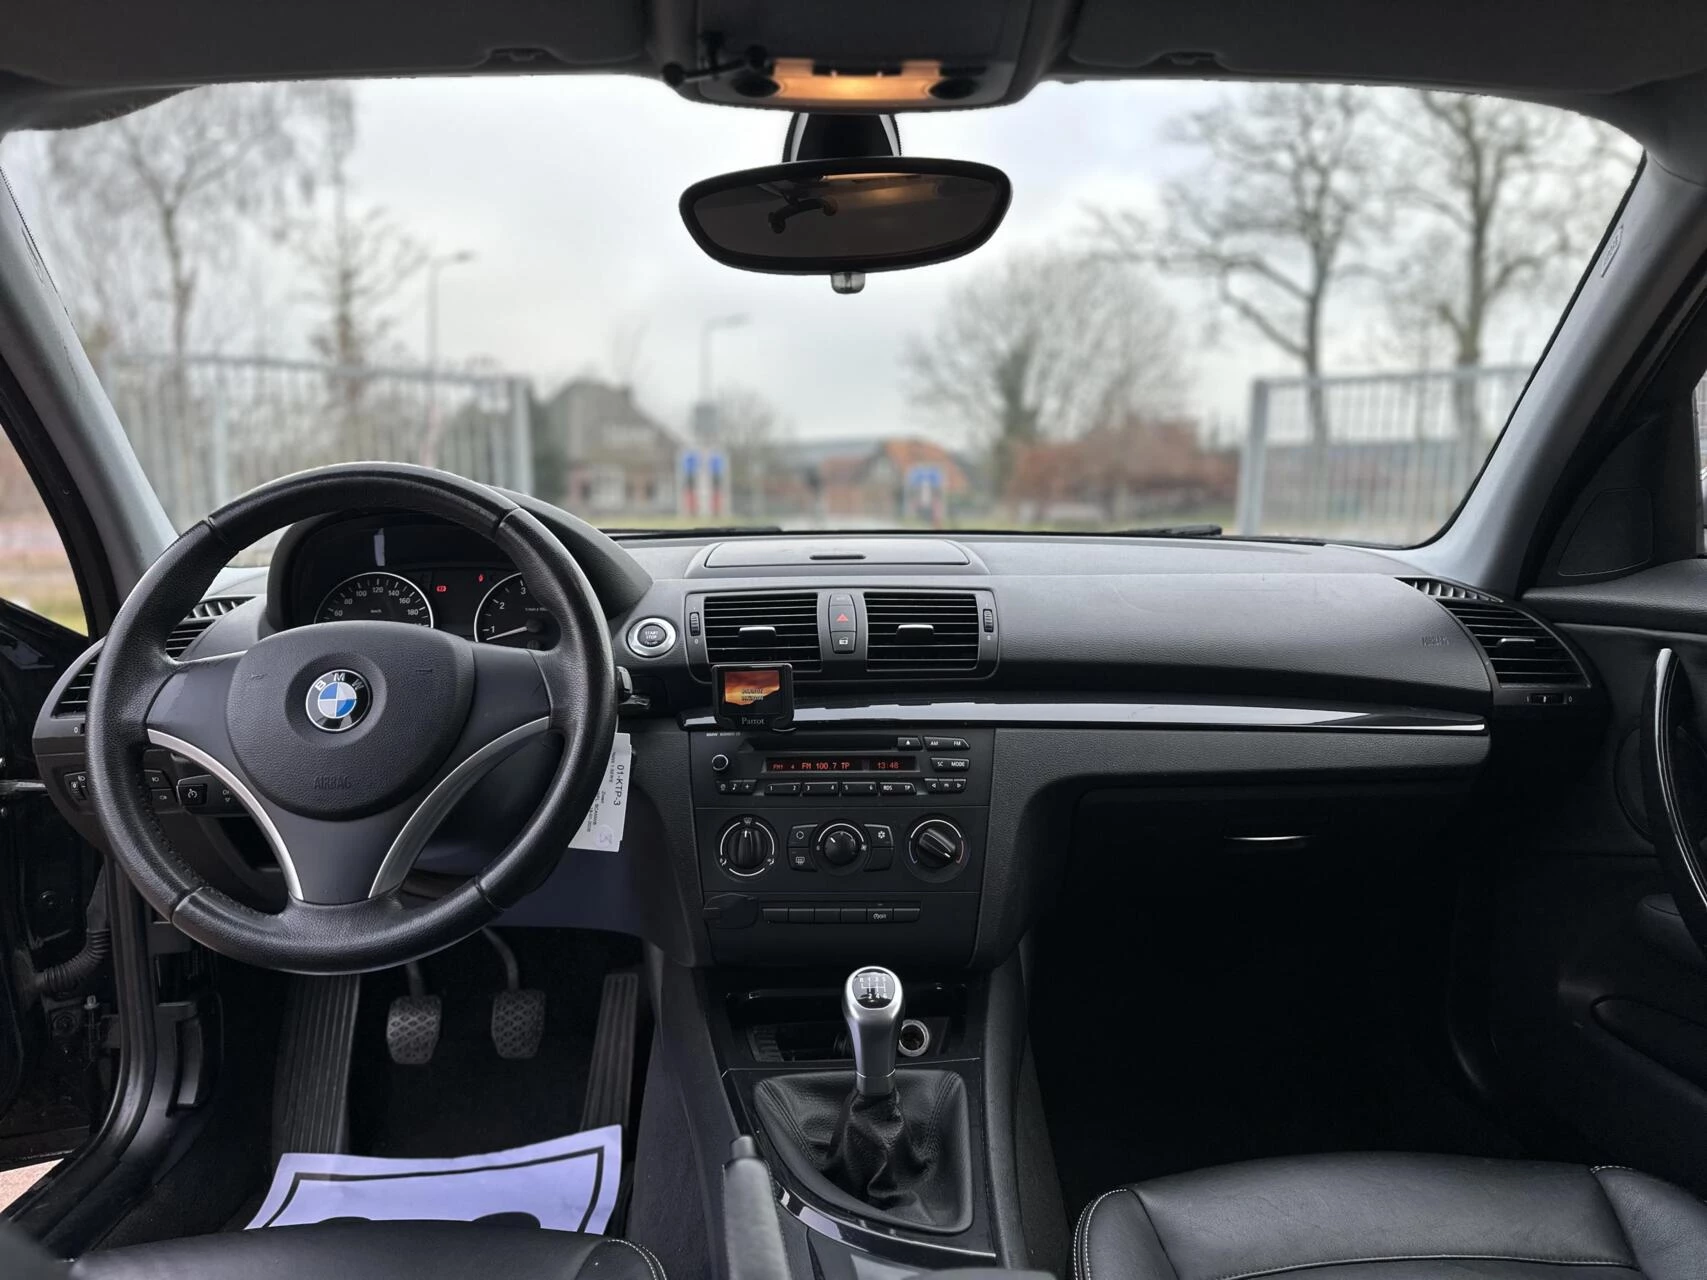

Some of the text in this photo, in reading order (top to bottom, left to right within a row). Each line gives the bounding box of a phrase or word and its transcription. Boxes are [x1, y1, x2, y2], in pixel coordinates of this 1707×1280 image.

[520, 587, 526, 595] 3
[315, 672, 364, 690] BMW
[741, 716, 765, 724] Parrot
[314, 777, 352, 790] AIRBAG
[613, 764, 625, 806] 01-KTP-3
